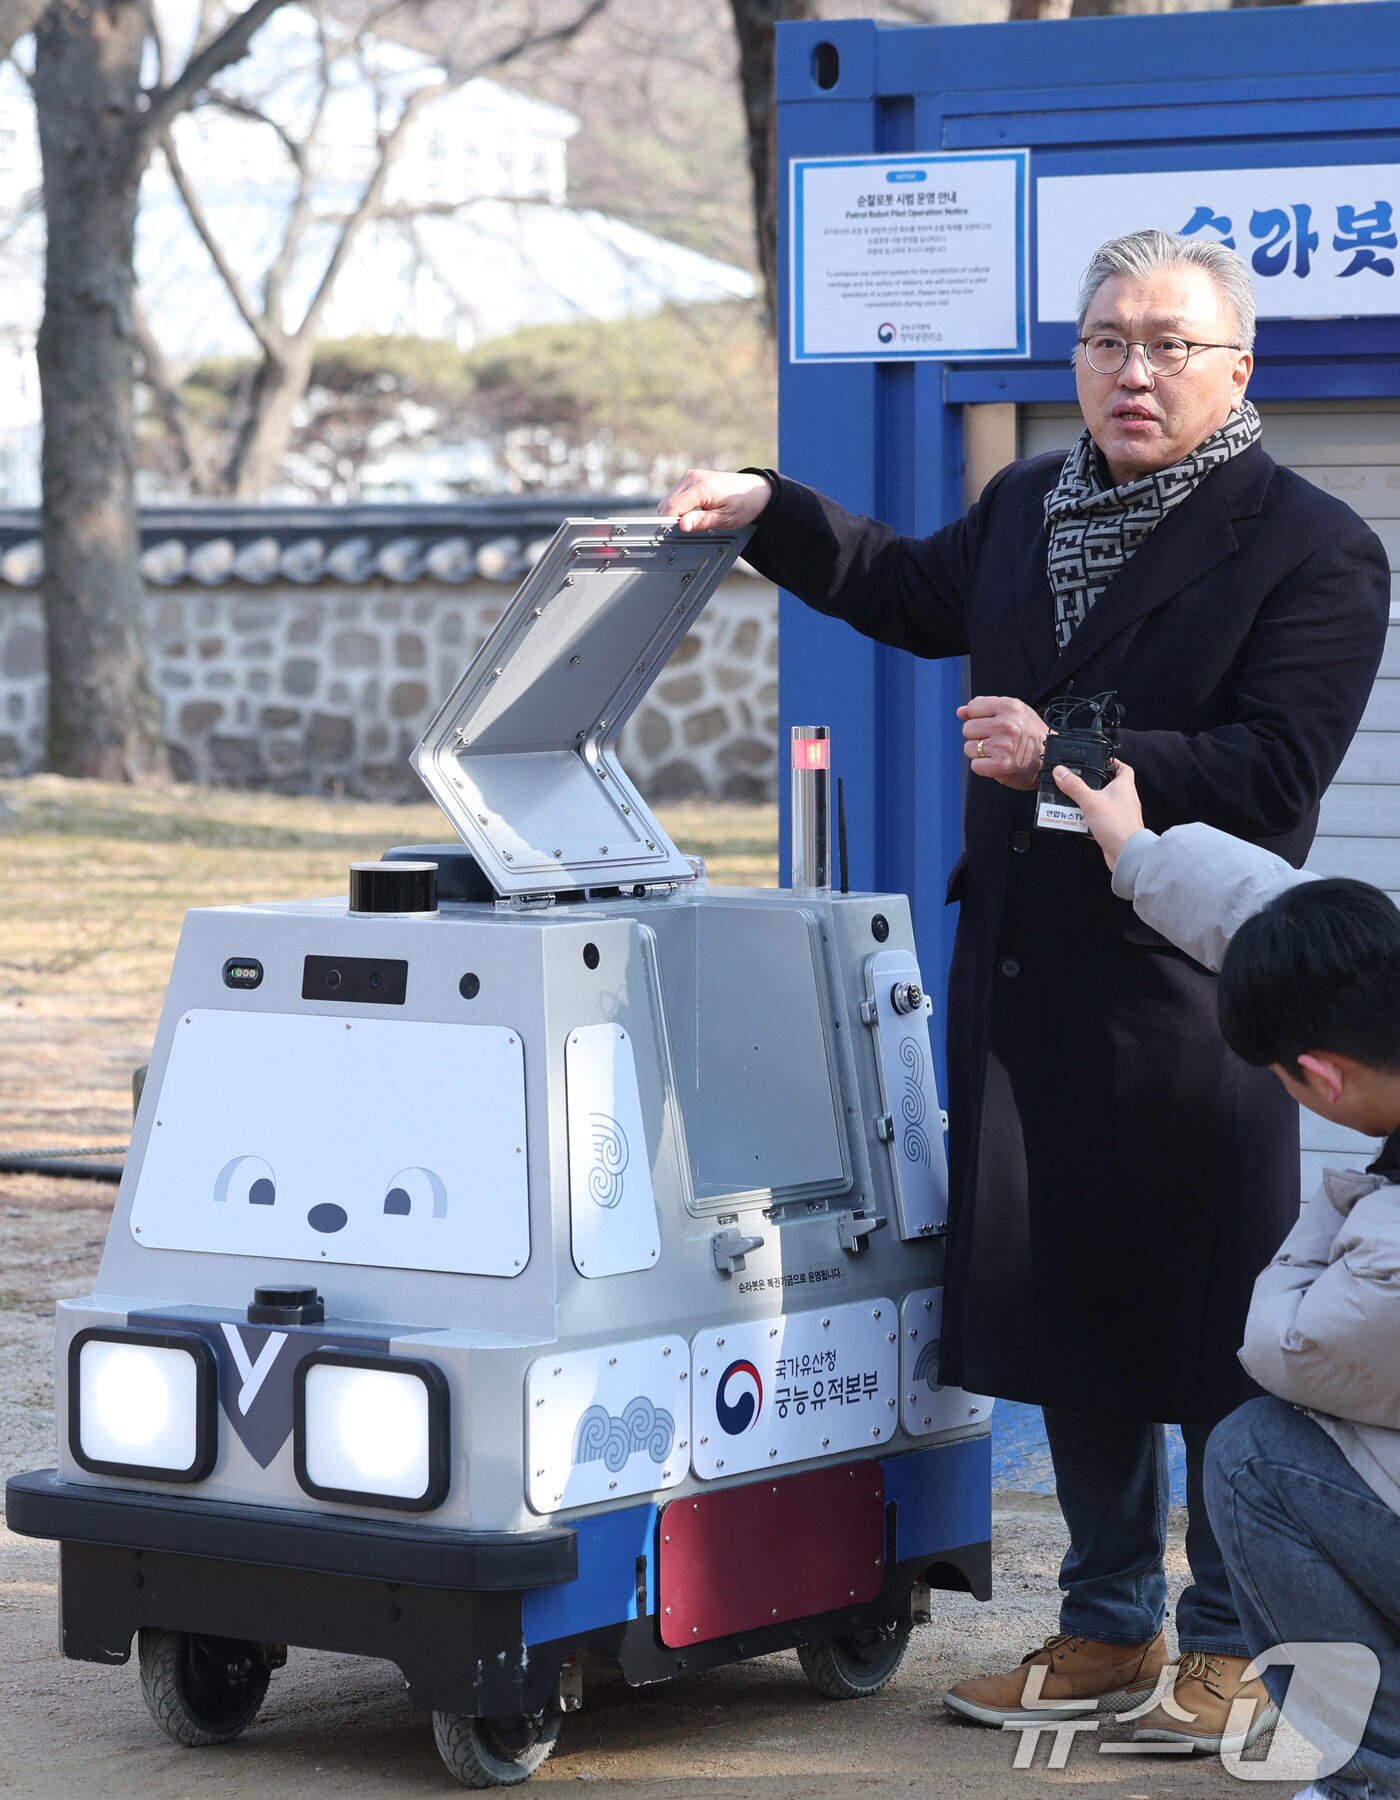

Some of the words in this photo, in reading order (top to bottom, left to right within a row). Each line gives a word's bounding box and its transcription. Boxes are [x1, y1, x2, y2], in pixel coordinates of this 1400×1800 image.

[857, 194, 894, 208] 순찰로봇
[896, 193, 915, 206] 시범
[917, 192, 936, 206] 운영
[937, 191, 957, 205] 안내
[846, 211, 867, 219] Patrol
[868, 210, 890, 218] Robot
[891, 209, 906, 217] Pilot
[907, 208, 943, 217] Operation
[945, 207, 968, 215] Notice
[1046, 809, 1085, 821] 연합뉴스TV
[738, 1279, 765, 1294] 순라봇은
[767, 1273, 807, 1289] 복권기금으로
[808, 1267, 843, 1283] 운영됩니다.
[775, 1349, 837, 1380] 국가유산청
[775, 1370, 879, 1419] 궁능유적본부
